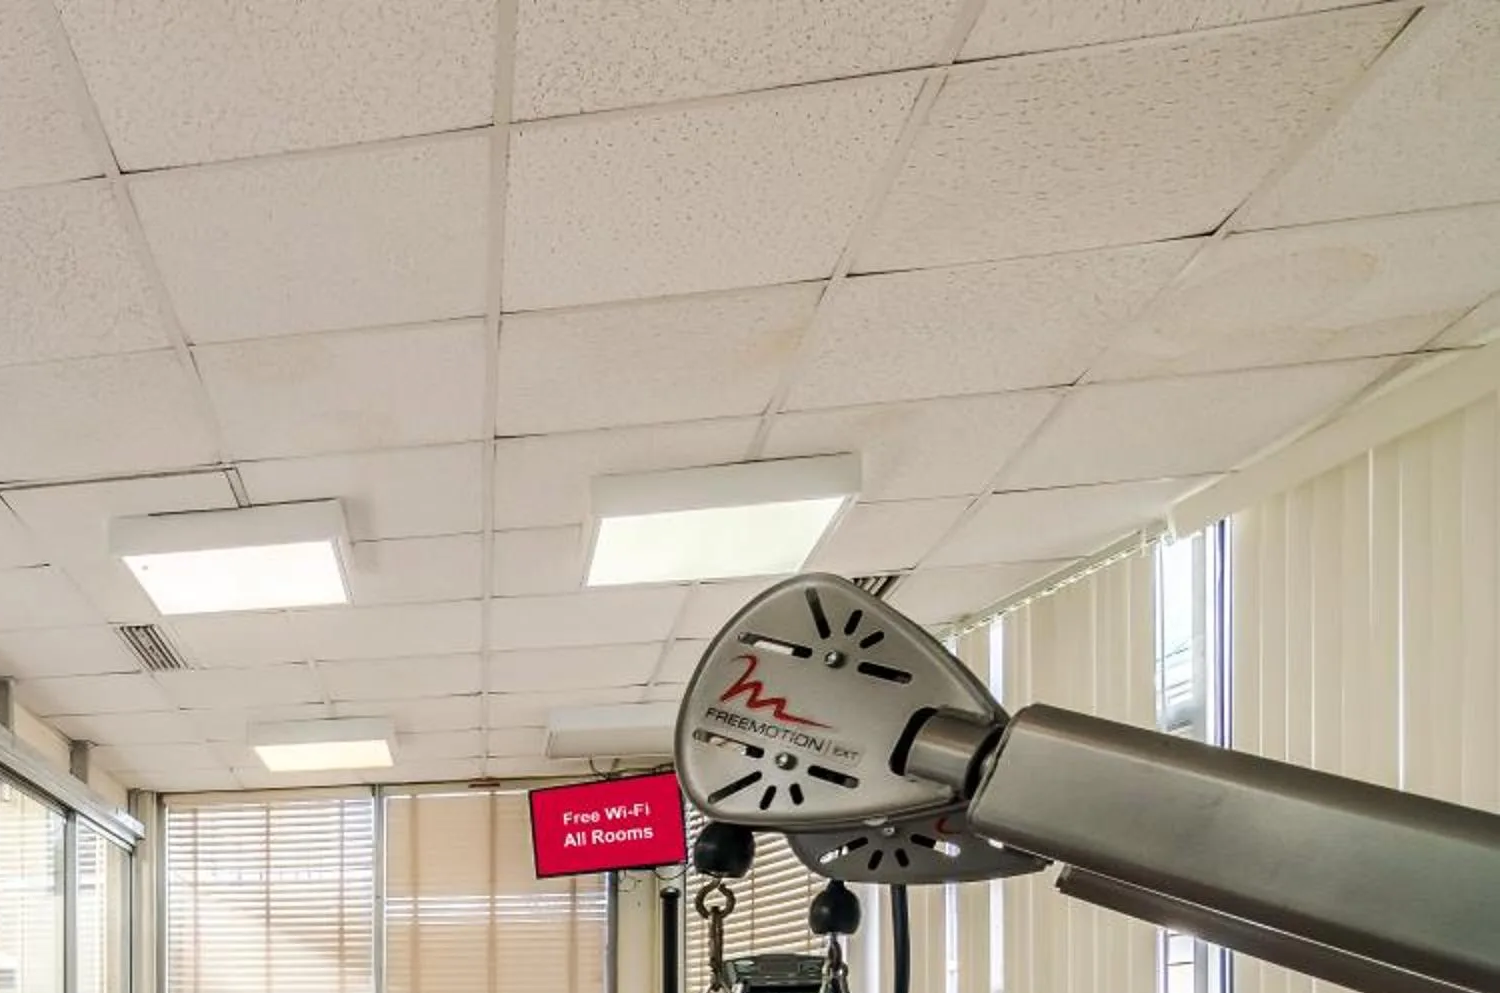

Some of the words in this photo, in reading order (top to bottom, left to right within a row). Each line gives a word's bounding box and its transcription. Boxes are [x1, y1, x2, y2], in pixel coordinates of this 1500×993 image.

[705, 707, 825, 752] FREEMOTION
[563, 811, 601, 826] Free
[604, 801, 651, 820] Wi-Fi
[563, 831, 587, 848] All
[591, 827, 654, 845] Rooms
